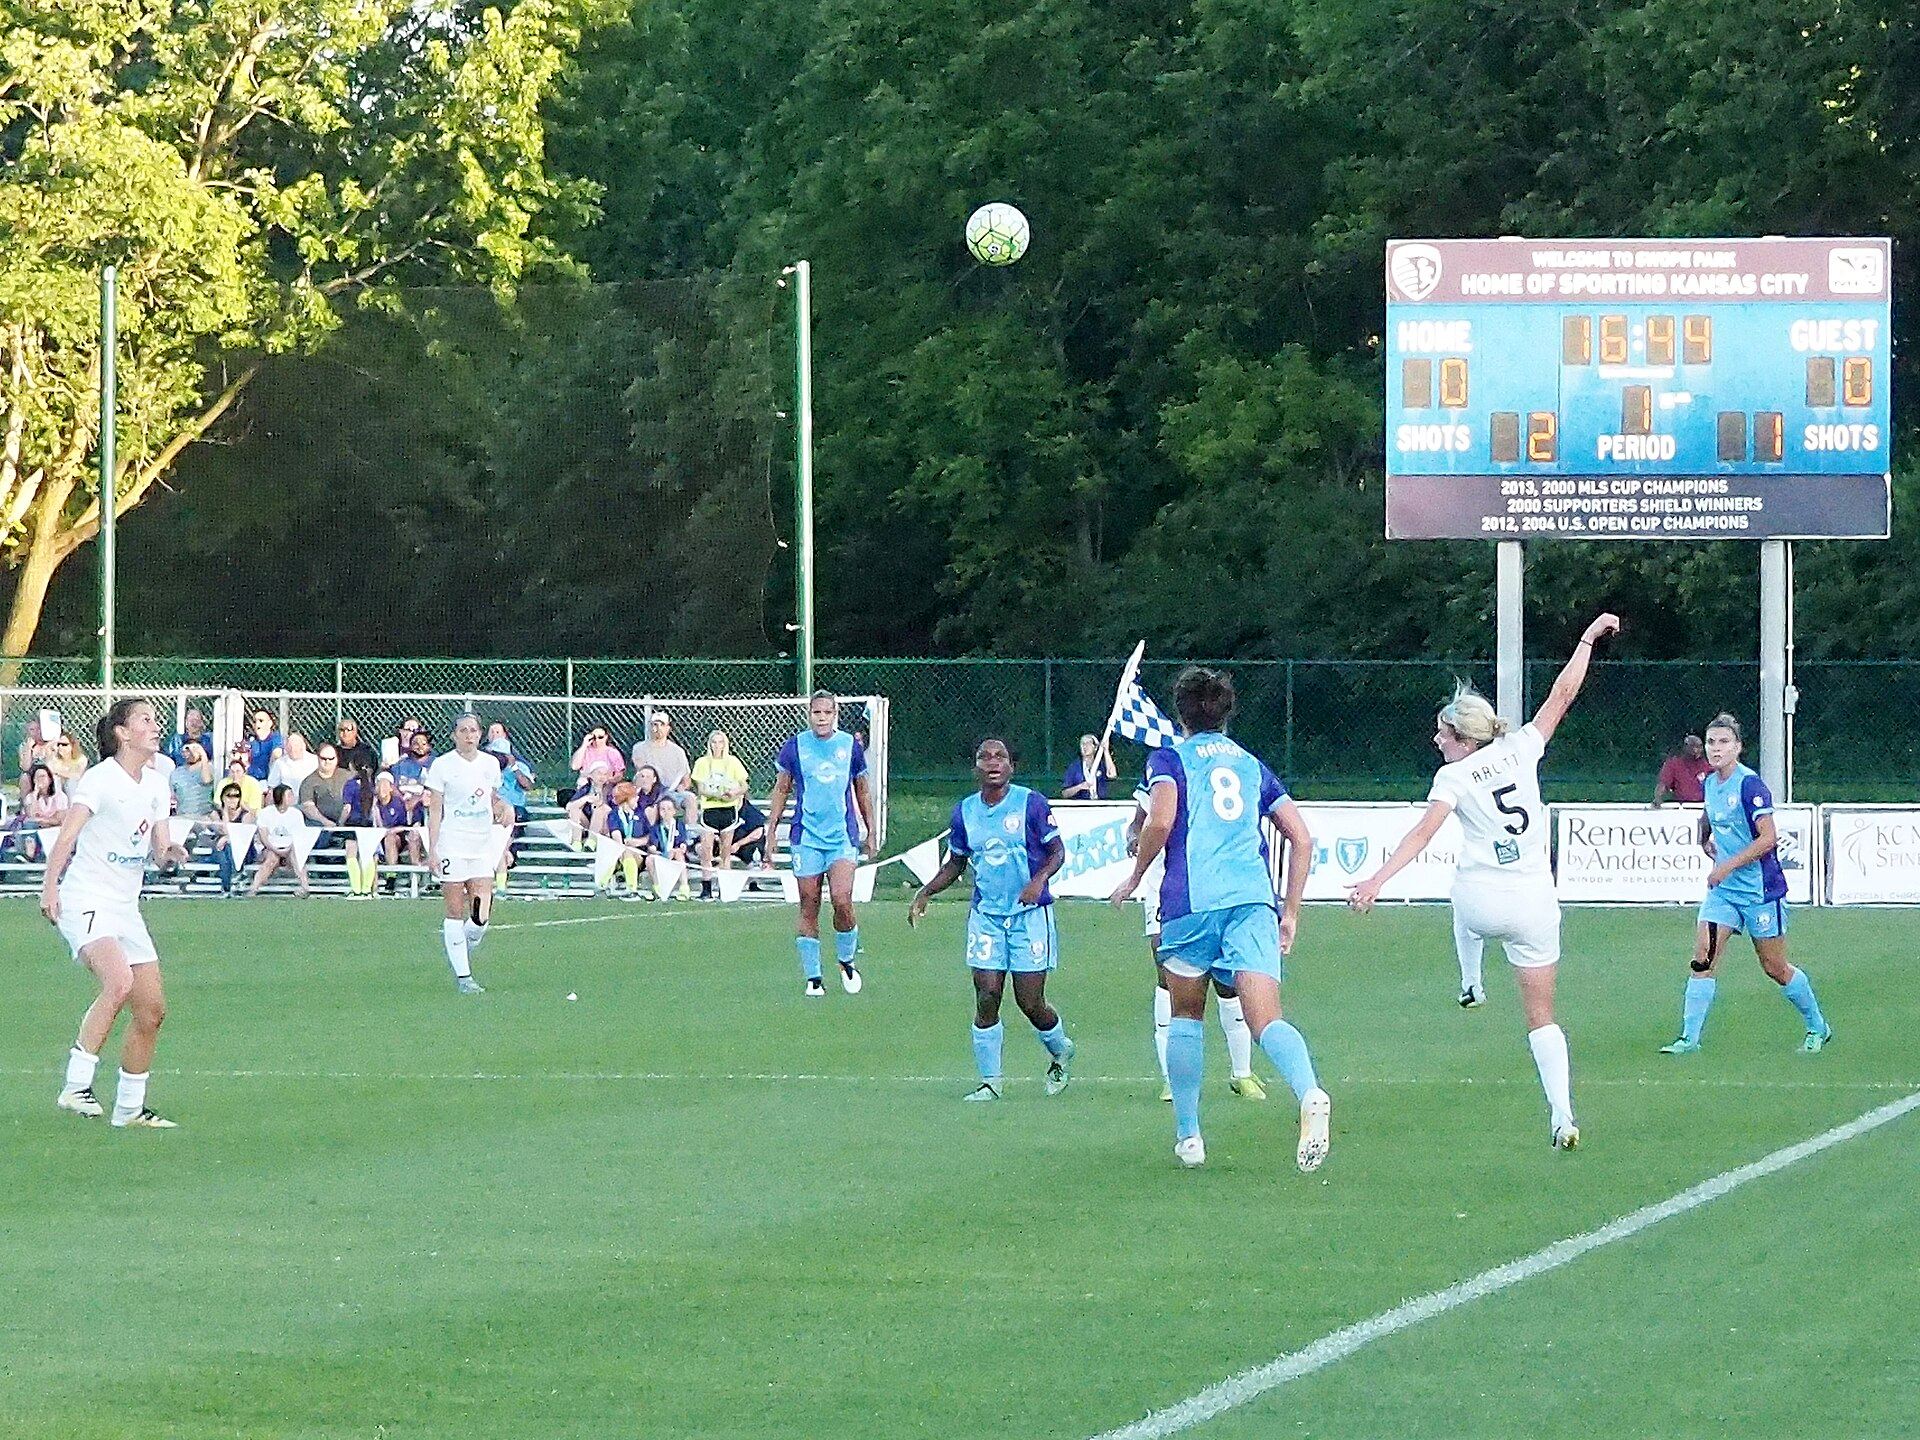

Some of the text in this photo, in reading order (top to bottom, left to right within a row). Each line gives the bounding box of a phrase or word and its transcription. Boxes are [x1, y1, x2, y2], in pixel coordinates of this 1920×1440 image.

[1532, 251, 1610, 268] WELCOME
[1611, 251, 1633, 268] TO
[1692, 251, 1737, 268] PARK
[1461, 274, 1523, 295] HOME
[1526, 274, 1556, 295] OF
[1558, 273, 1667, 295] SPORTING
[1669, 273, 1757, 295] KANSAS
[1760, 273, 1809, 295] CITY
[1398, 320, 1472, 352] HOME
[1582, 314, 1710, 363] 16:44
[1790, 319, 1878, 352] GUEST
[1441, 359, 1467, 405] 0
[1844, 358, 1871, 405] 0
[1397, 424, 1470, 452] SHOTS
[1529, 412, 1555, 460] 2
[1597, 435, 1675, 460] PERIOD
[1804, 424, 1878, 451] SHOTS
[1541, 480, 1576, 495] 2000
[1578, 480, 1609, 495] MLS
[1610, 480, 1642, 495] CUP
[1642, 479, 1729, 495] CHAMPIONS
[1507, 496, 1763, 513] 2000 SUPPORTERS SHIELD WINNERS
[1481, 516, 1519, 533] 2012,
[1558, 516, 1586, 531] U.S.
[1588, 516, 1628, 531] OPEN
[1630, 516, 1662, 531] CUP
[1663, 515, 1749, 530] CHAMPIONS
[1209, 767, 1244, 821] 8
[1492, 783, 1529, 835] 5
[1568, 817, 1702, 846] Renewal
[1877, 825, 1903, 845] KC
[441, 858, 451, 875] 2
[1568, 876, 1701, 884] WINDOW REPLACEMENT
[82, 910, 96, 934] 7
[967, 932, 993, 960] 23
